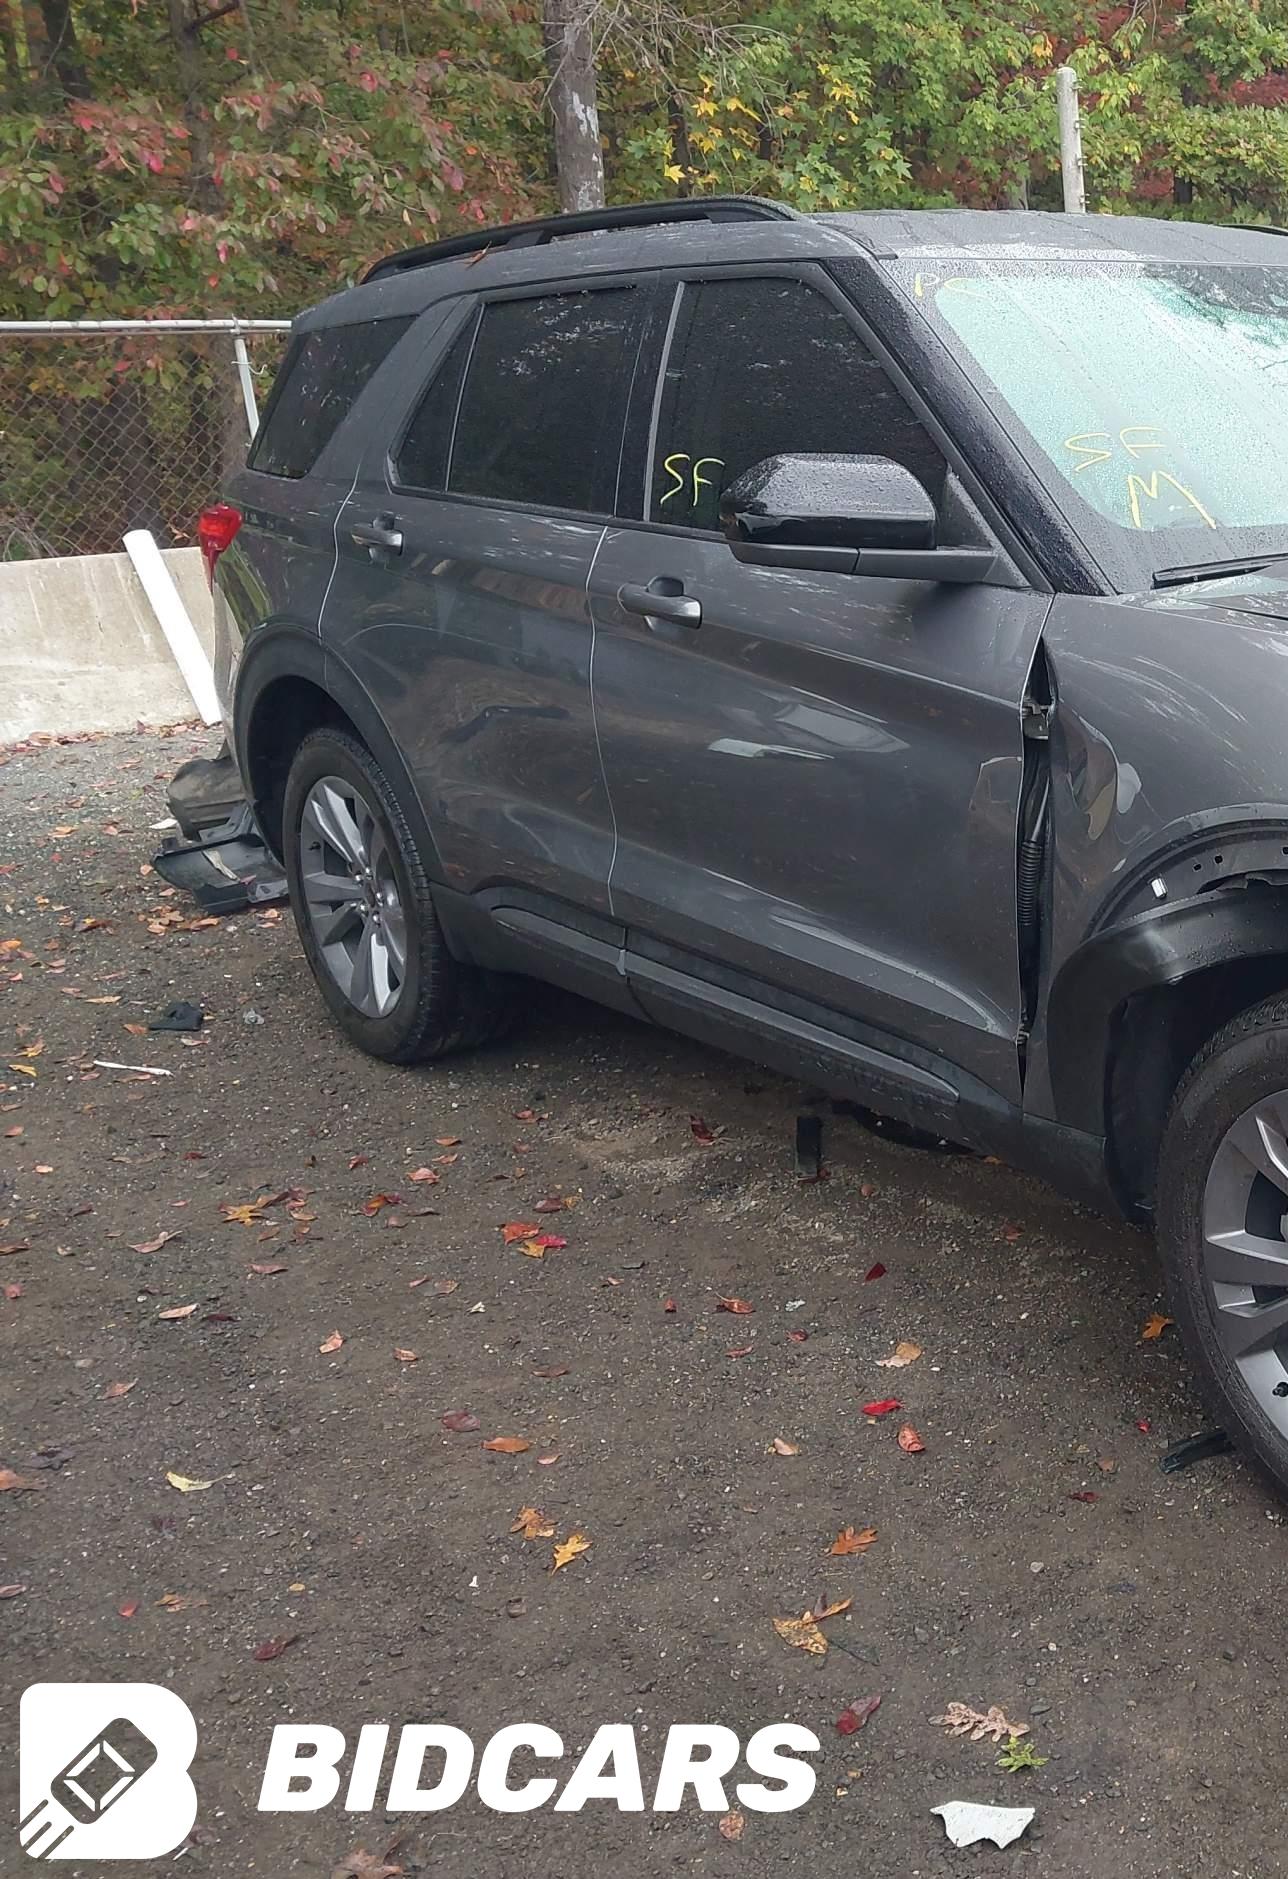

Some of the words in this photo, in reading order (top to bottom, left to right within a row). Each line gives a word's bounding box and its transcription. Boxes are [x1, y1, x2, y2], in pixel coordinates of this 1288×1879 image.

[1064, 426, 1168, 473] SF
[660, 453, 725, 506] SF
[1127, 470, 1216, 529] M
